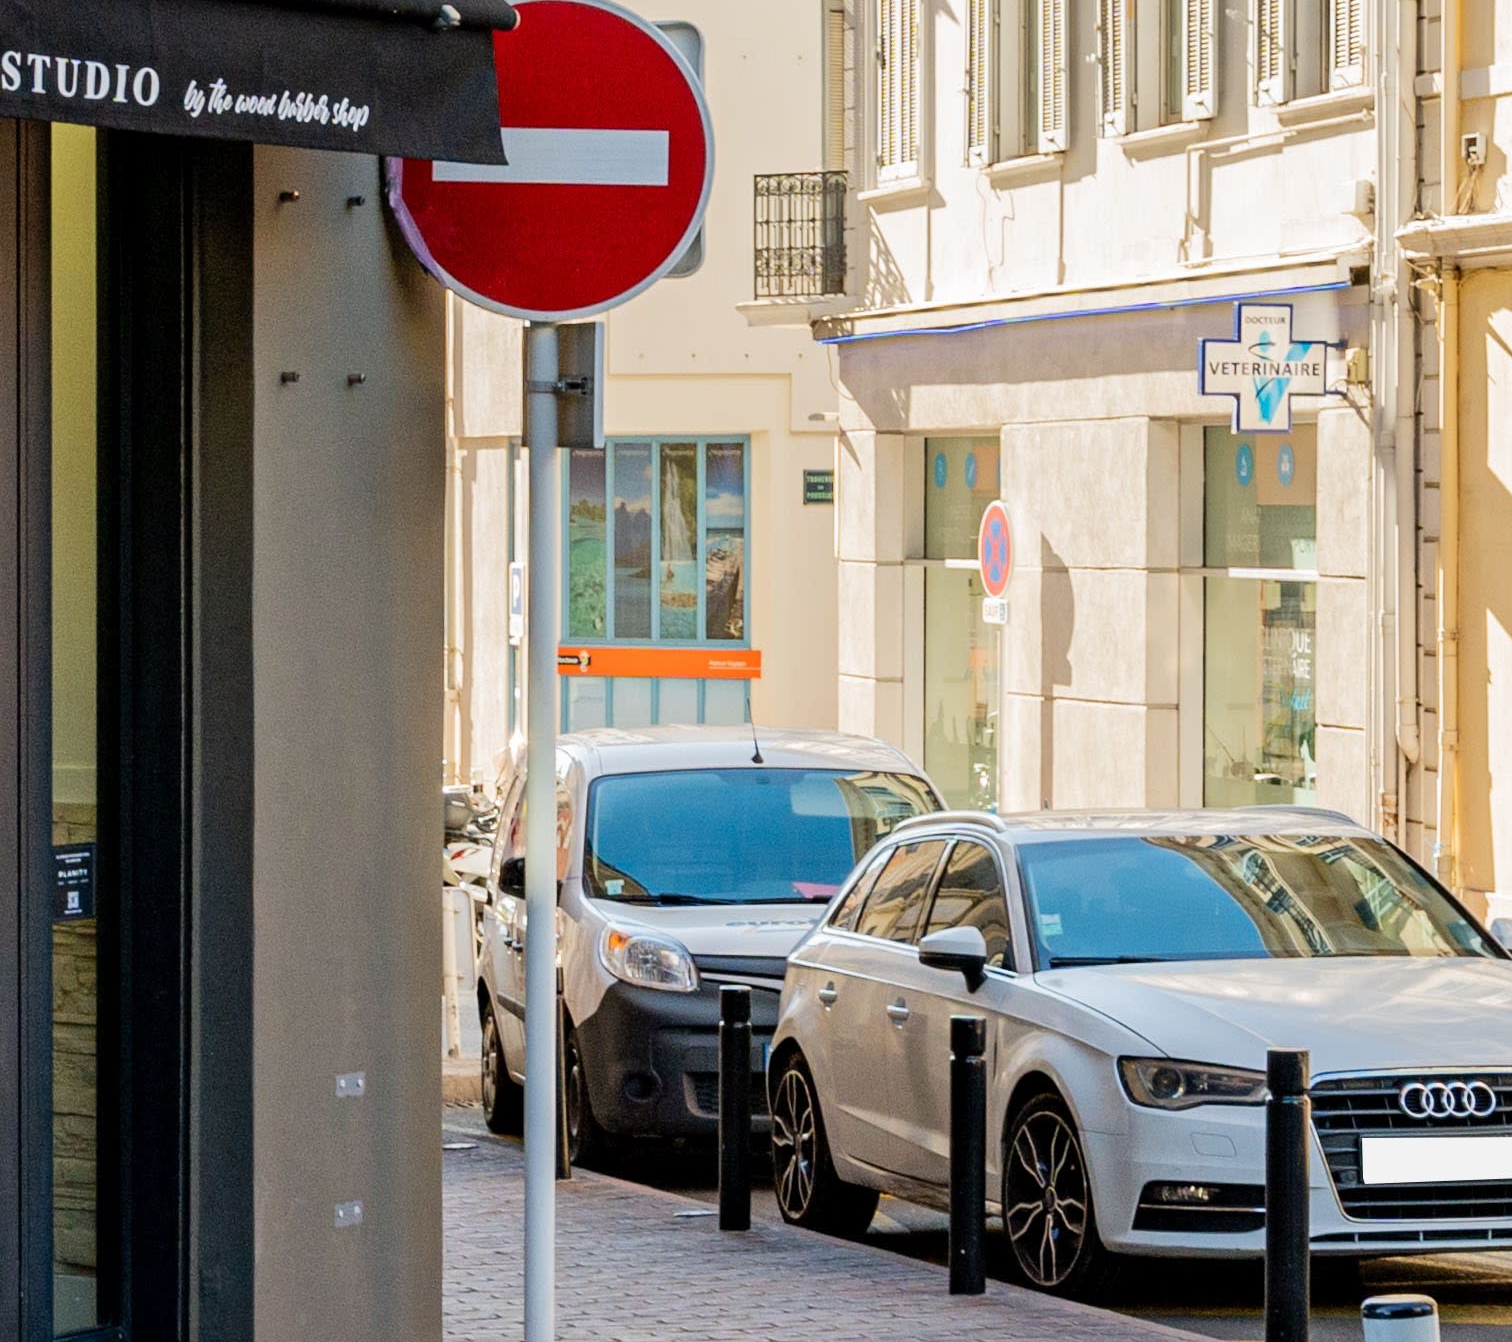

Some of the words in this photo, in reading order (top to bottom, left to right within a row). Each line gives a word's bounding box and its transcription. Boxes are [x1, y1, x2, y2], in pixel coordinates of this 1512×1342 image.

[0, 50, 161, 107] STUDIO
[183, 79, 206, 119] by
[207, 77, 233, 115] the
[277, 90, 330, 126] barber
[331, 96, 370, 133] shop
[1244, 316, 1287, 324] DOCTEUR
[1209, 361, 1321, 377] VETERINAIRE
